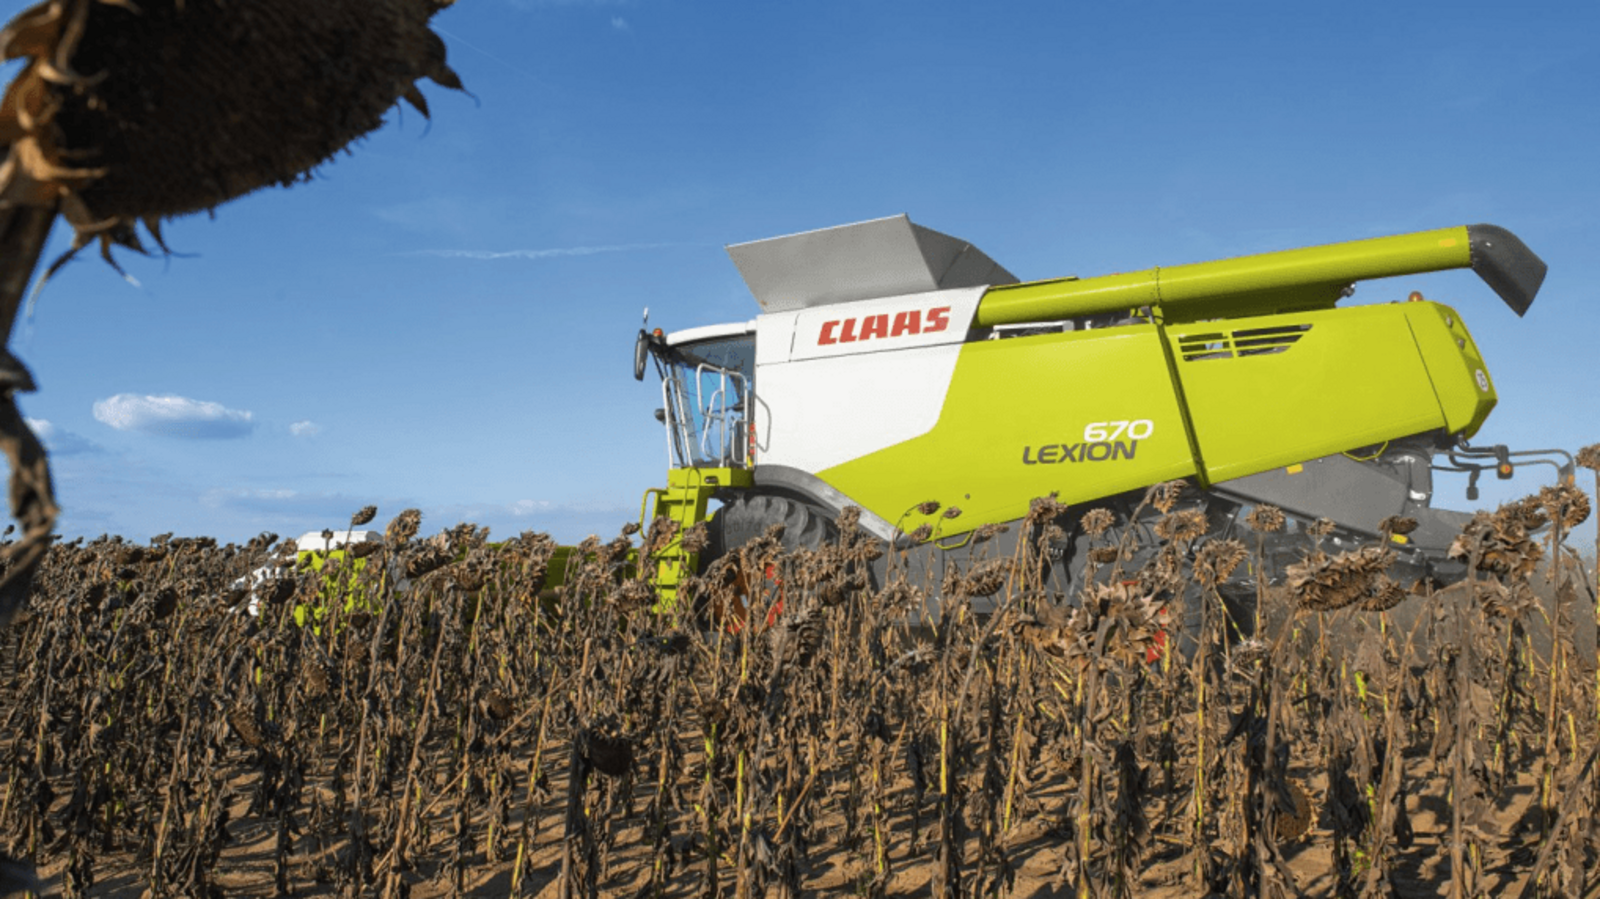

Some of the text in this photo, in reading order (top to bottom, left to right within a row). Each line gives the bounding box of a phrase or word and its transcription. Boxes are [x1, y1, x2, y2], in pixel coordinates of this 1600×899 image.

[817, 306, 951, 346] CLAAS
[1083, 419, 1154, 443] 670
[1022, 440, 1138, 465] LEXION
